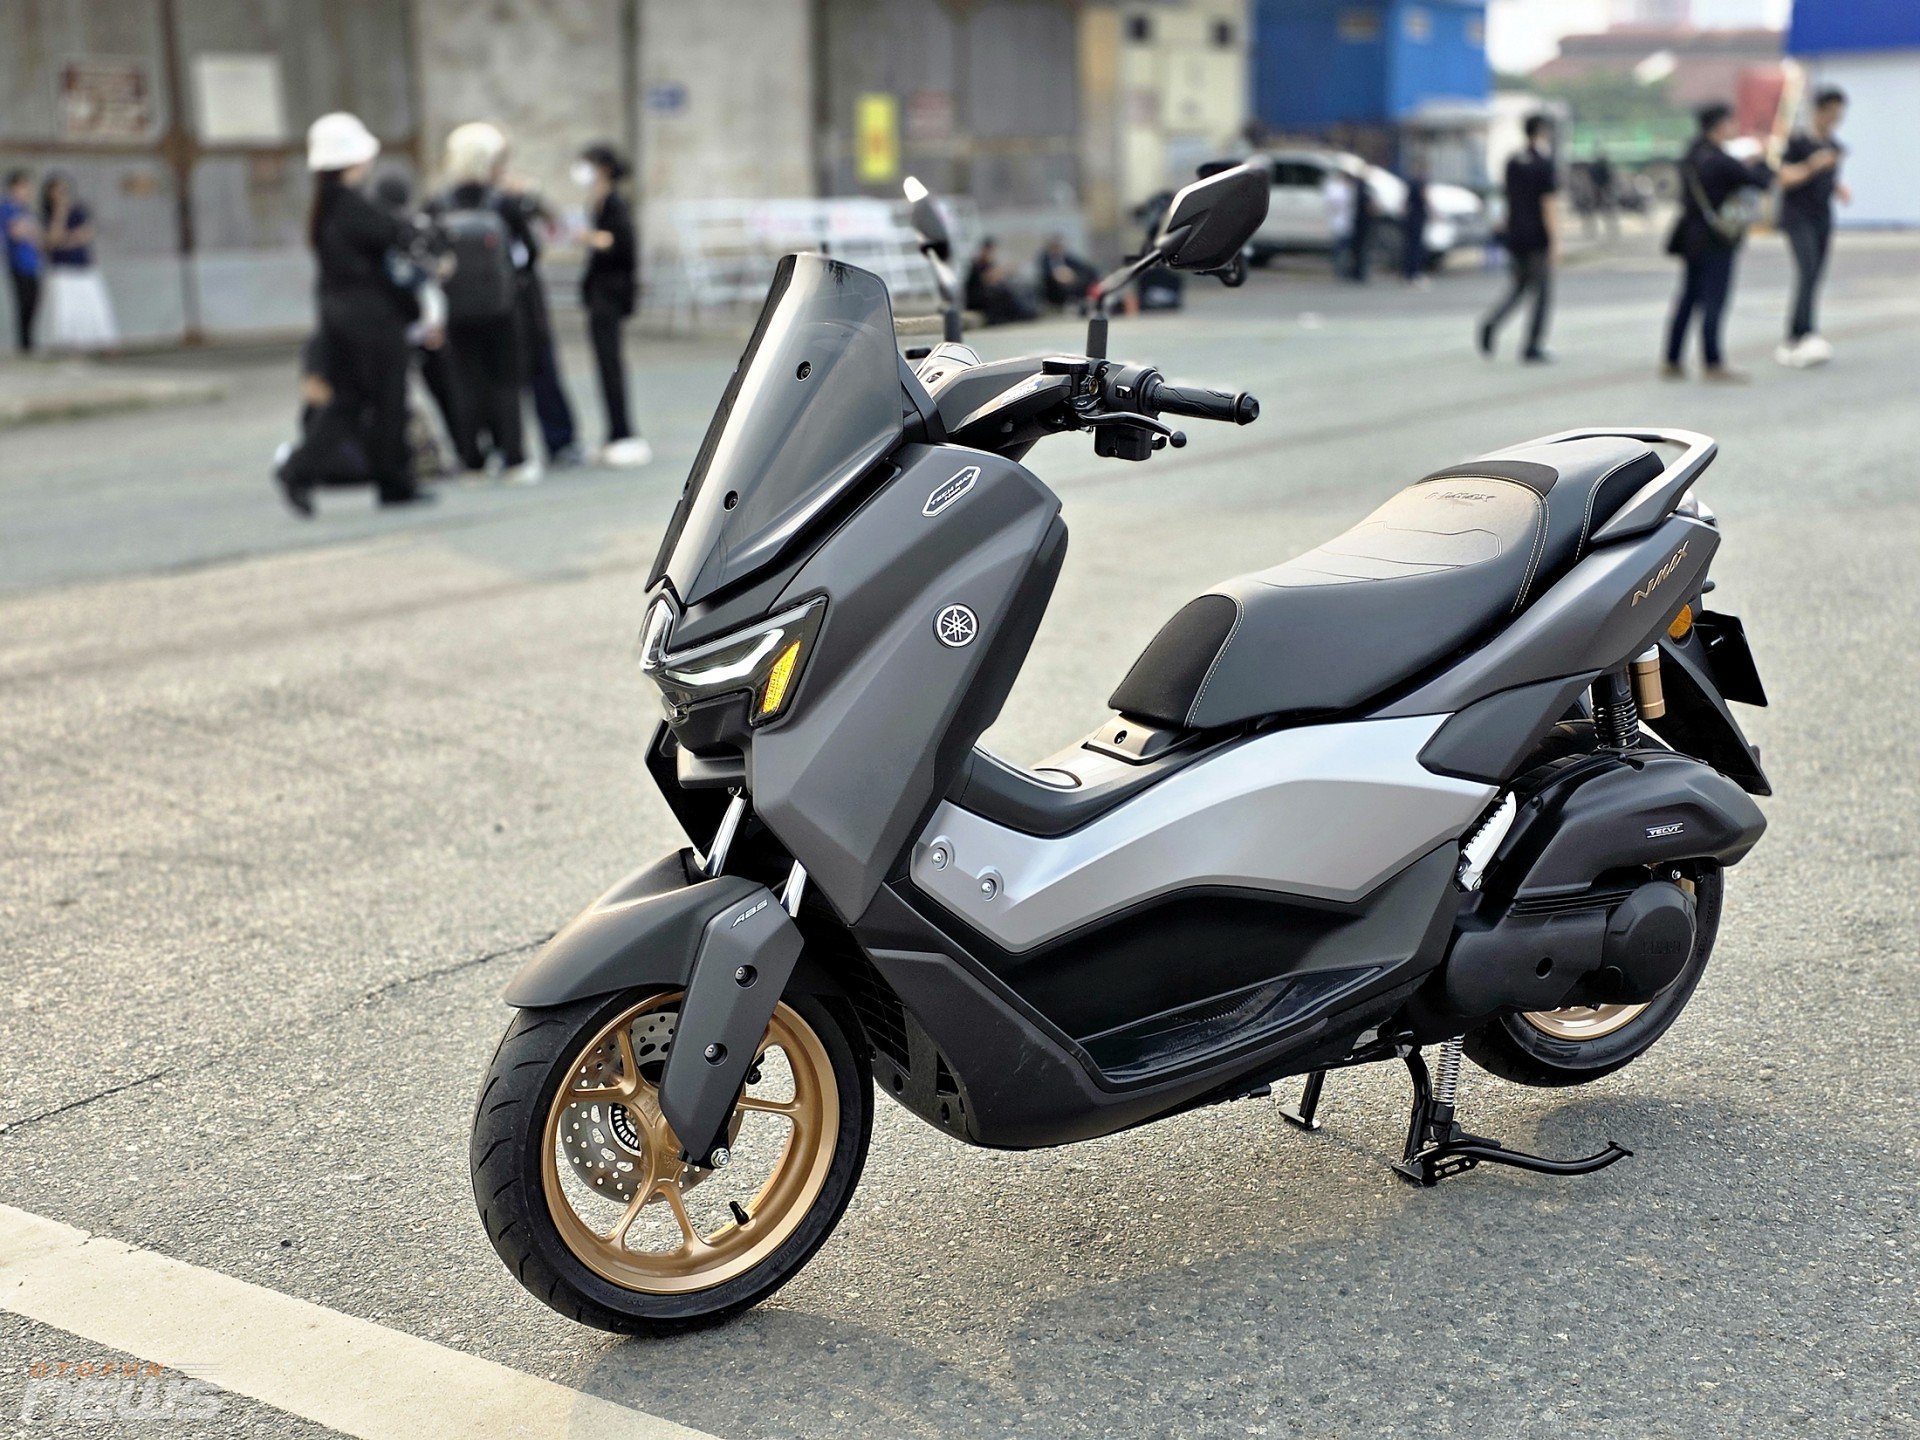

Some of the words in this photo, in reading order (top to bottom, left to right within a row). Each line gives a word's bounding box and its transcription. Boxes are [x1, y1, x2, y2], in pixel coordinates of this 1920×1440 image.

[1631, 540, 1690, 608] NMAX
[1649, 825, 1681, 836] YECVT
[731, 899, 768, 928] ABS
